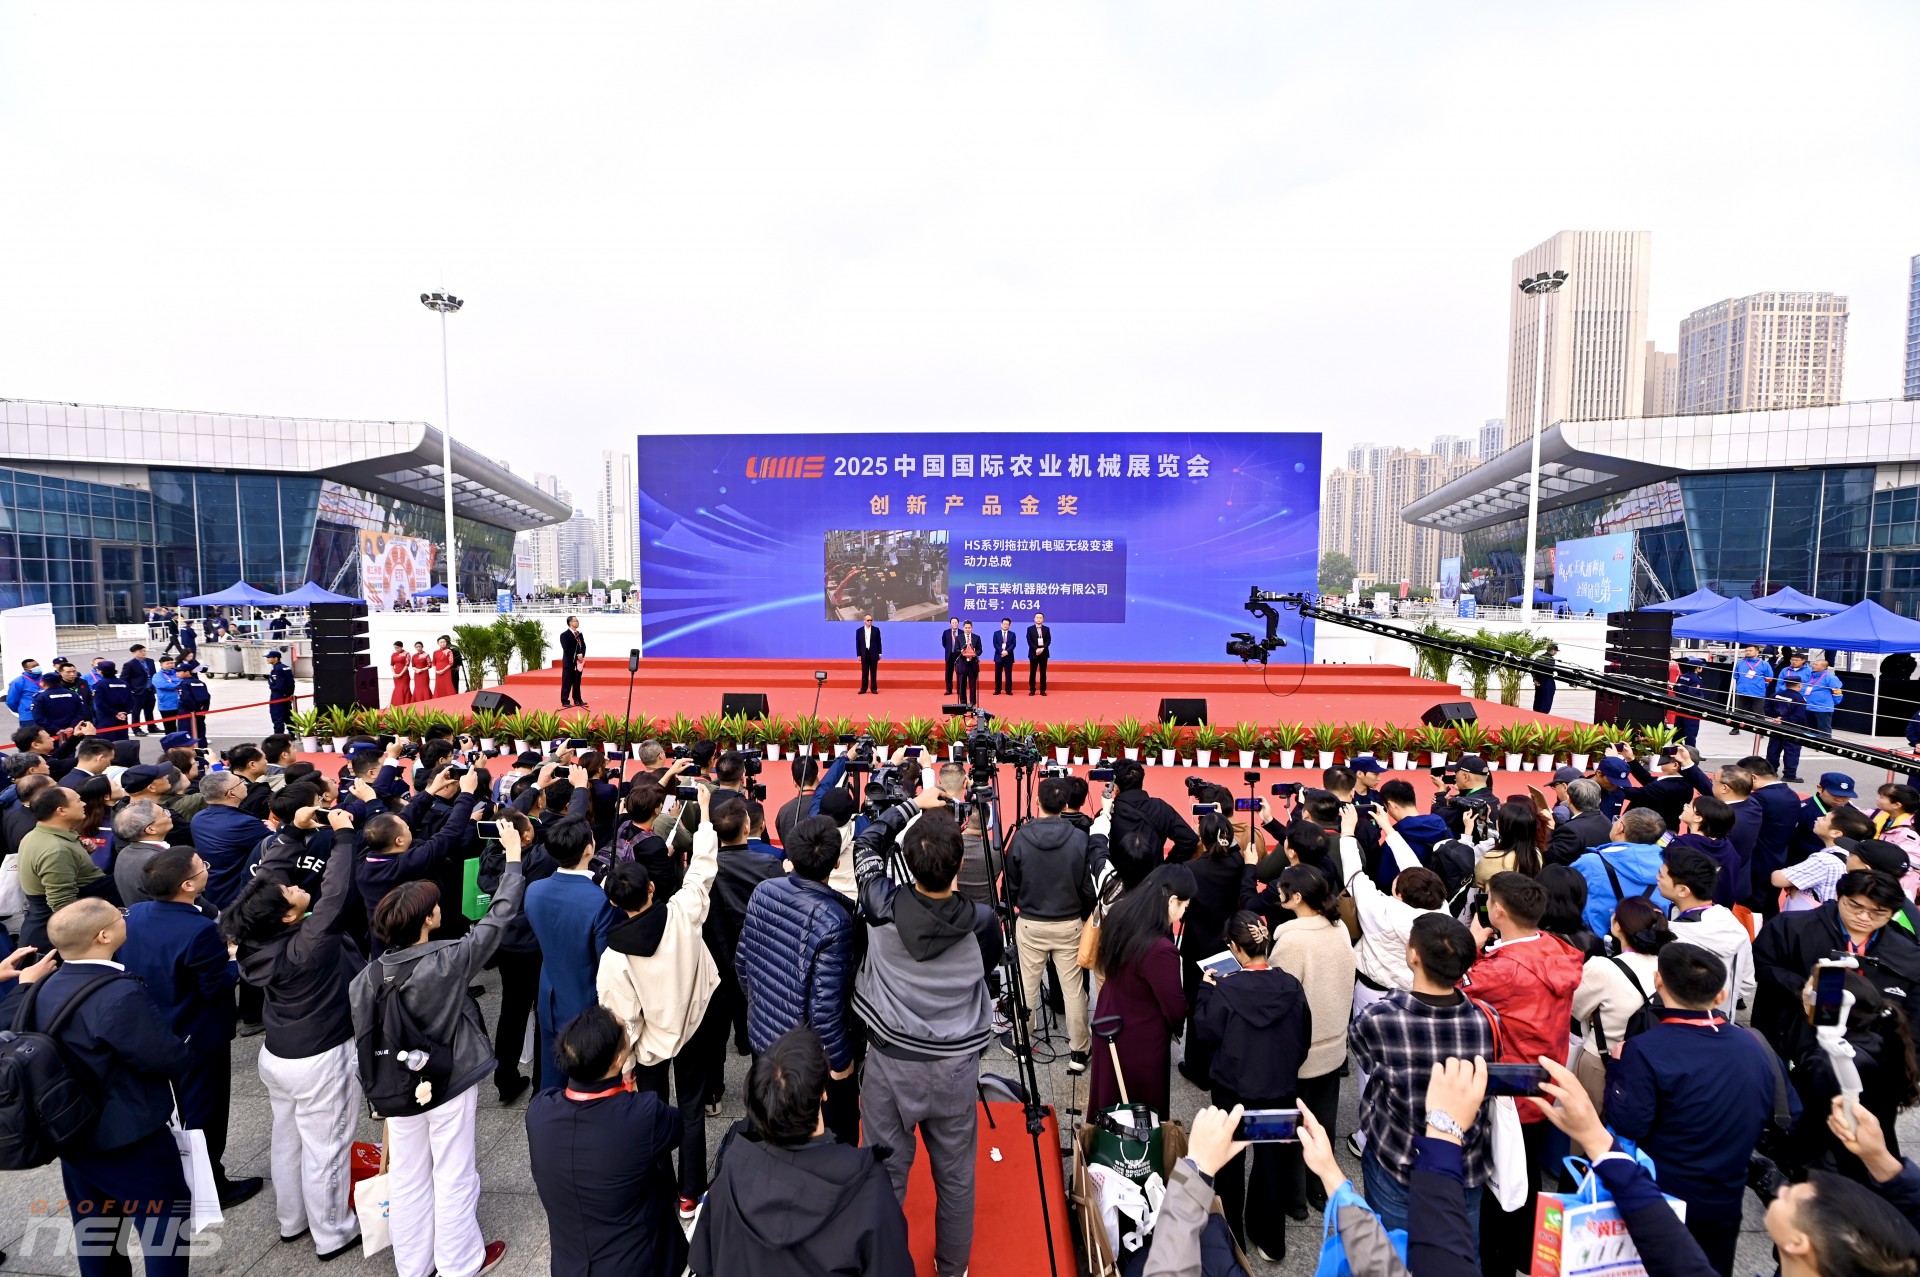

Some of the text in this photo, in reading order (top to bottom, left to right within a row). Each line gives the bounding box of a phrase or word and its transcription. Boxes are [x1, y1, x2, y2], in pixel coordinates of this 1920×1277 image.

[834, 454, 1210, 478] 2025中国国际农业机械展览会
[870, 495, 1078, 515] 创新产品金奖
[964, 539, 1114, 552] HS系列拖拉机电驱无级变速
[963, 555, 1012, 567] 动力总成
[963, 582, 1109, 596] 广西玉柴机器股份有限公司
